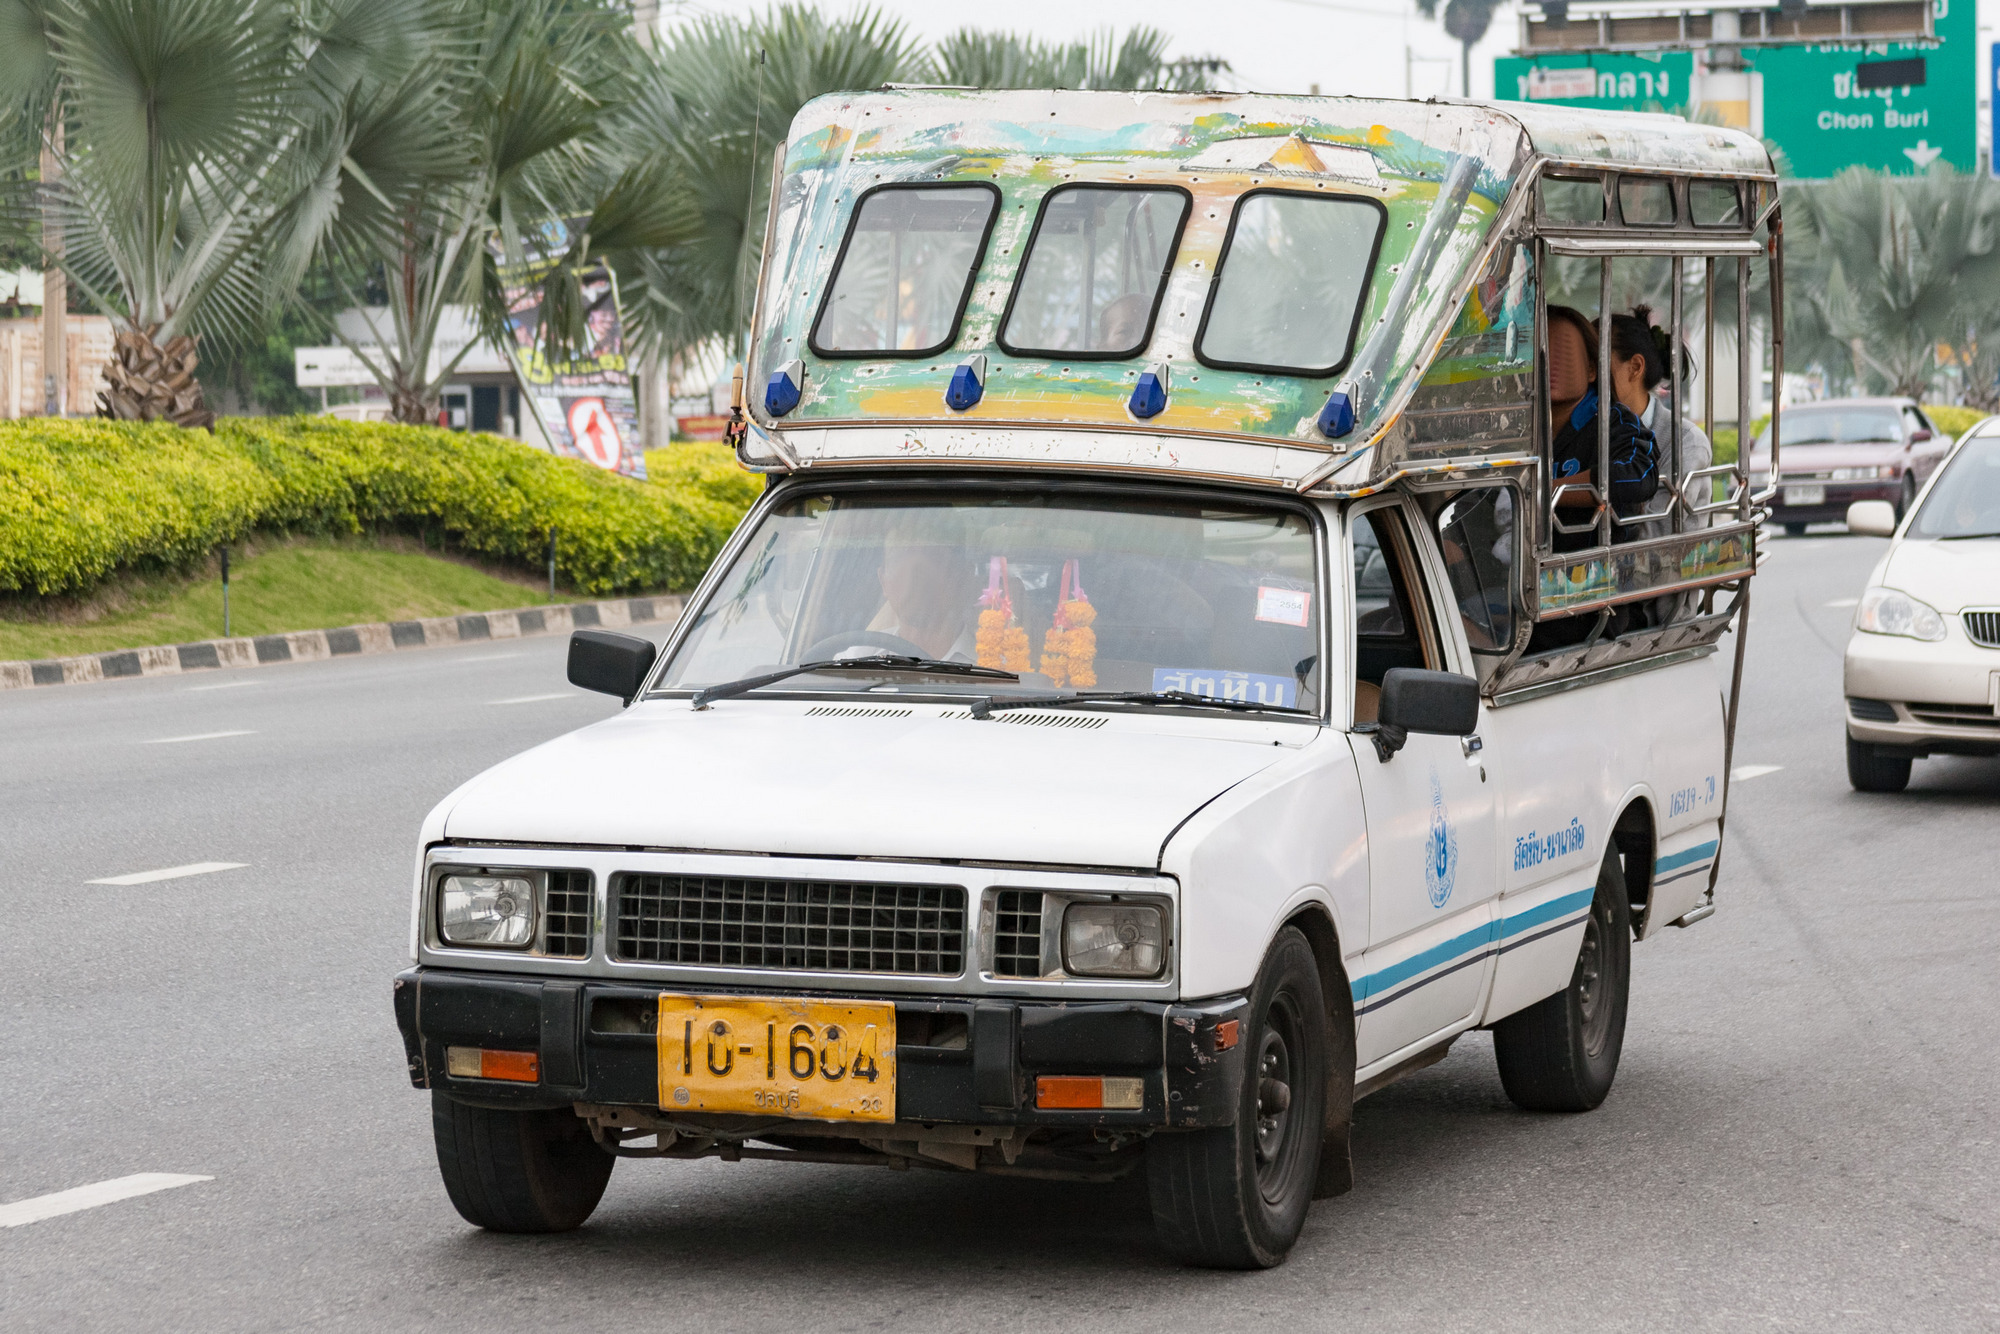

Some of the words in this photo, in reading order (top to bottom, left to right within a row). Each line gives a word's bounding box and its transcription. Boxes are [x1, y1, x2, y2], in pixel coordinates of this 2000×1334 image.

[1817, 110, 1874, 130] Chon
[1884, 108, 1928, 128] Buri
[1280, 600, 1303, 610] 2554
[684, 1018, 880, 1084] 10-1604
[753, 1085, 800, 1115] ชลบุรี
